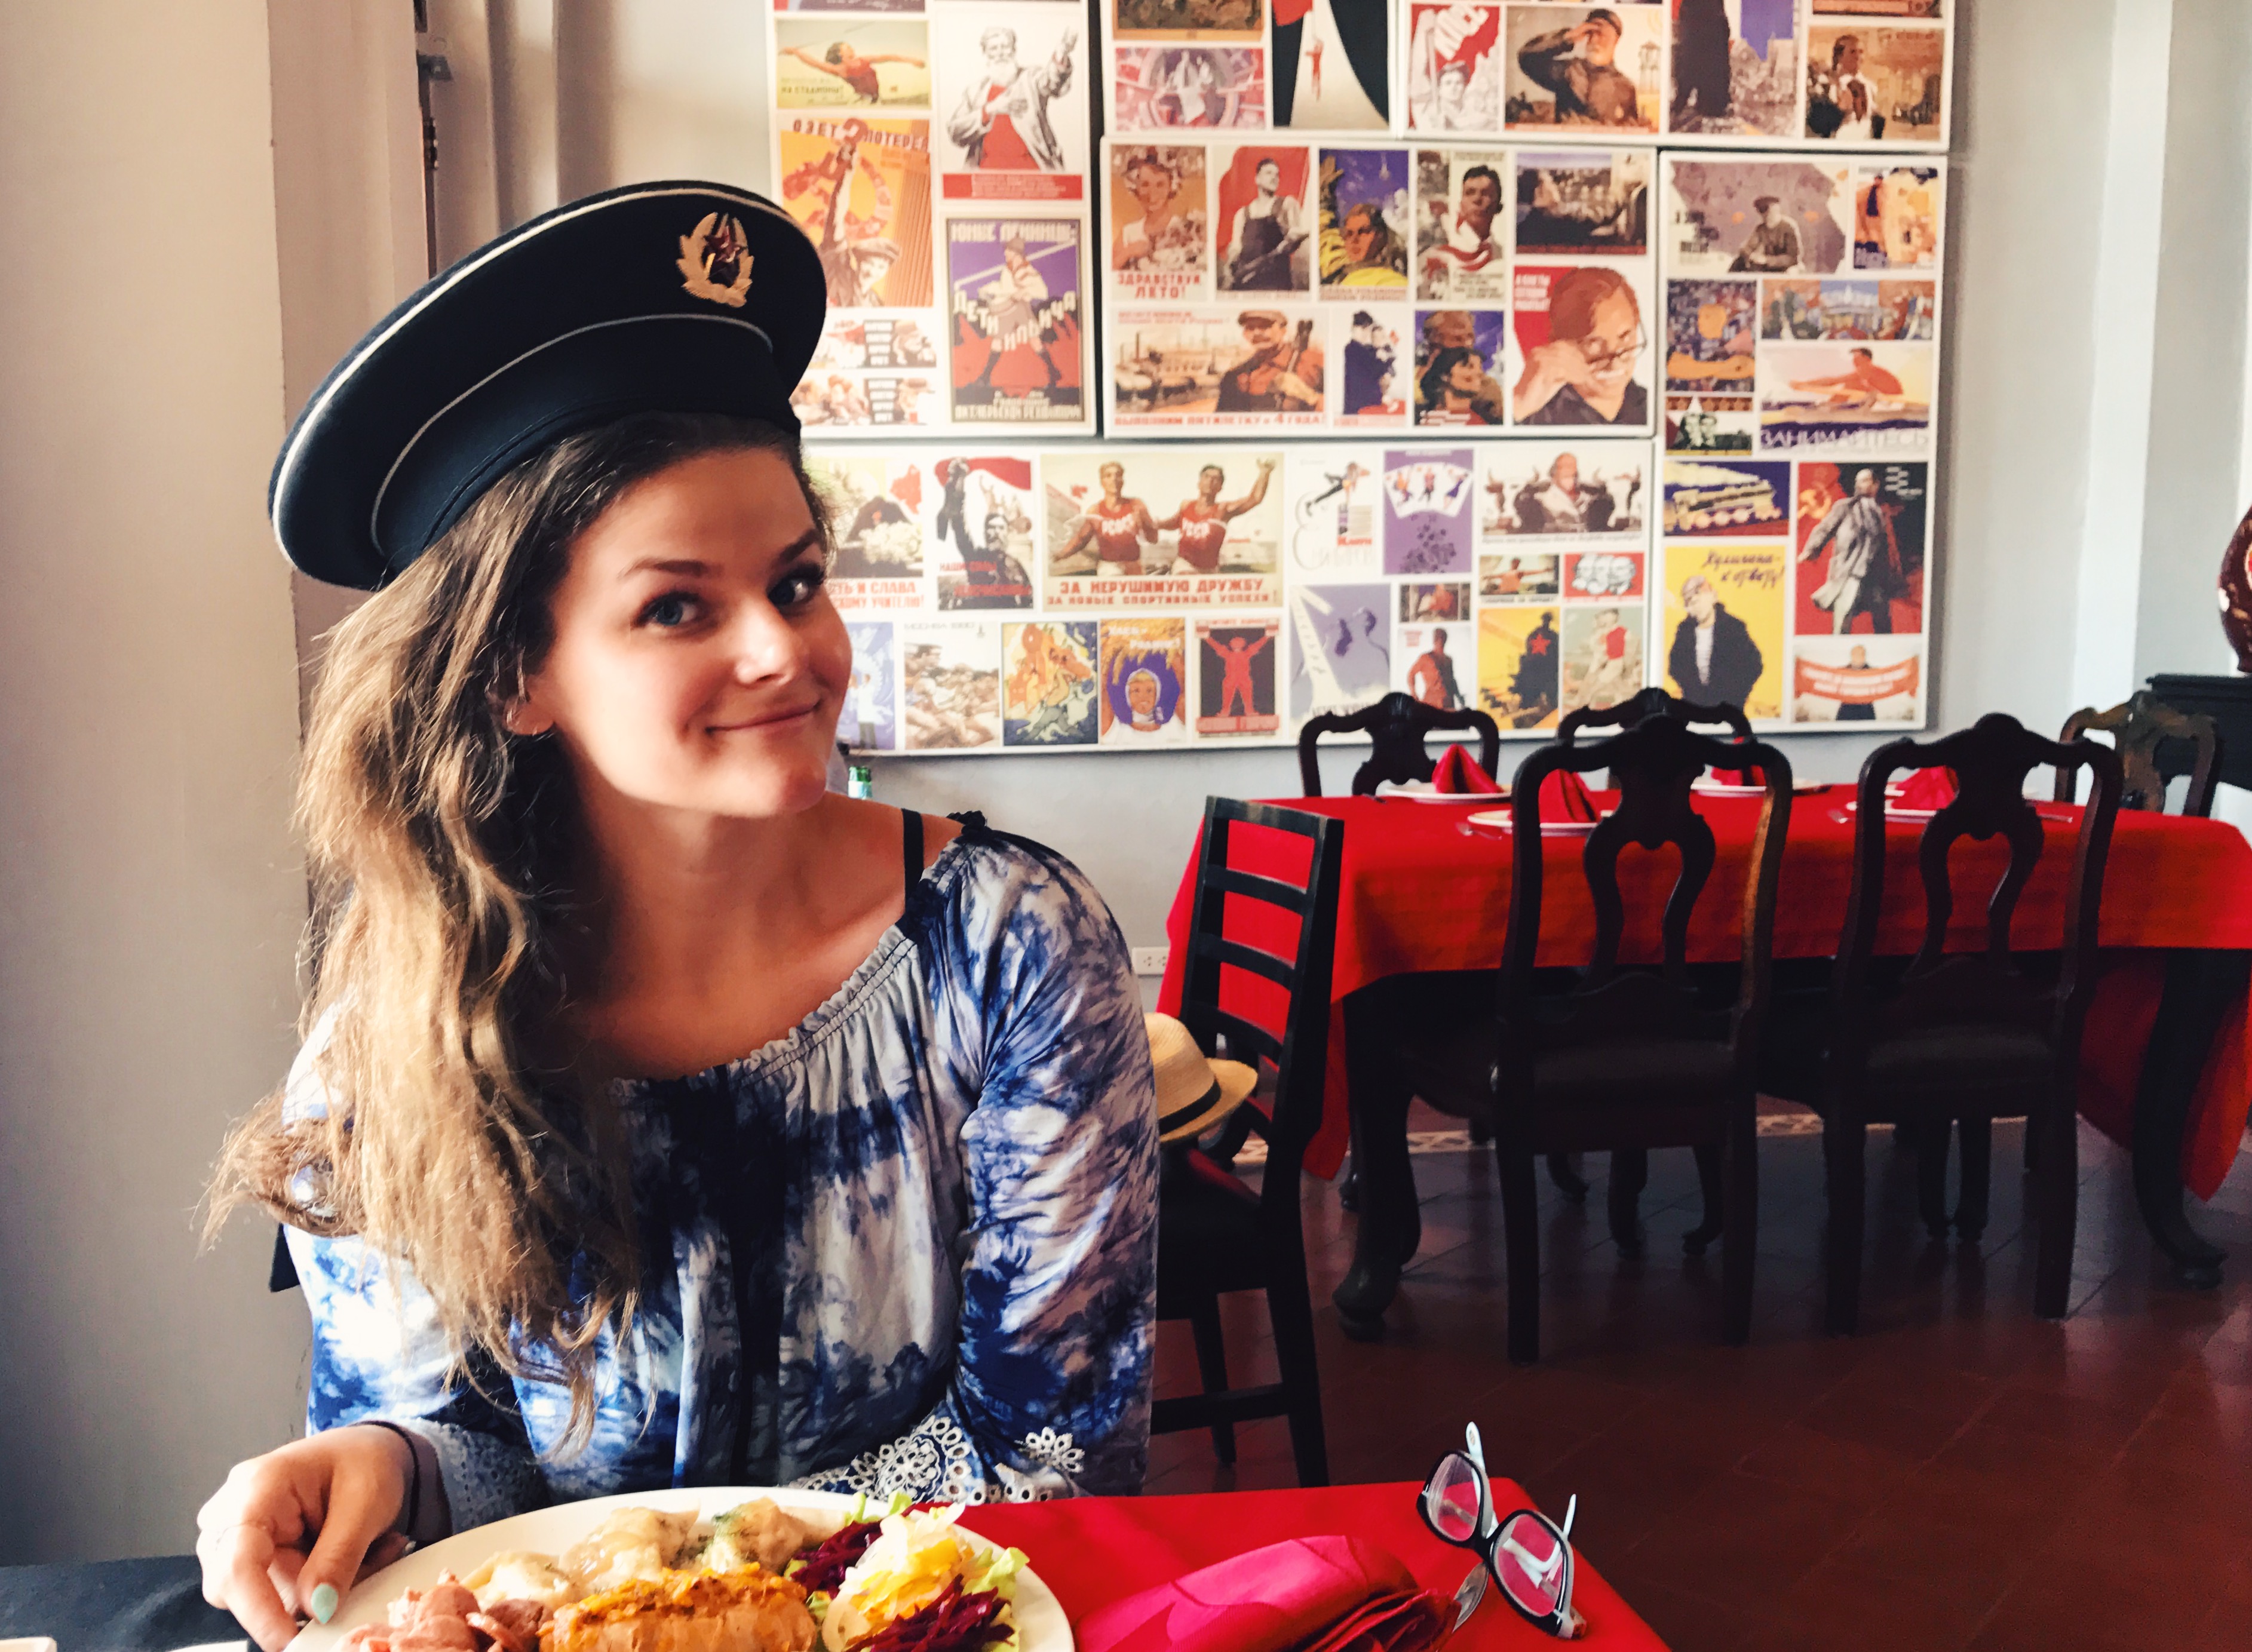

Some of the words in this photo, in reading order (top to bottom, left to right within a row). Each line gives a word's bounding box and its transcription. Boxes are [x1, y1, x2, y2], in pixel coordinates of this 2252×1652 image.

[870, 581, 916, 594] СЛАВА
[1060, 581, 1081, 594] ЗА
[1090, 579, 1189, 594] НЕРУШИМУЮ
[1196, 577, 1263, 592] ДРУЖБУ
[1048, 596, 1063, 604] ЗА
